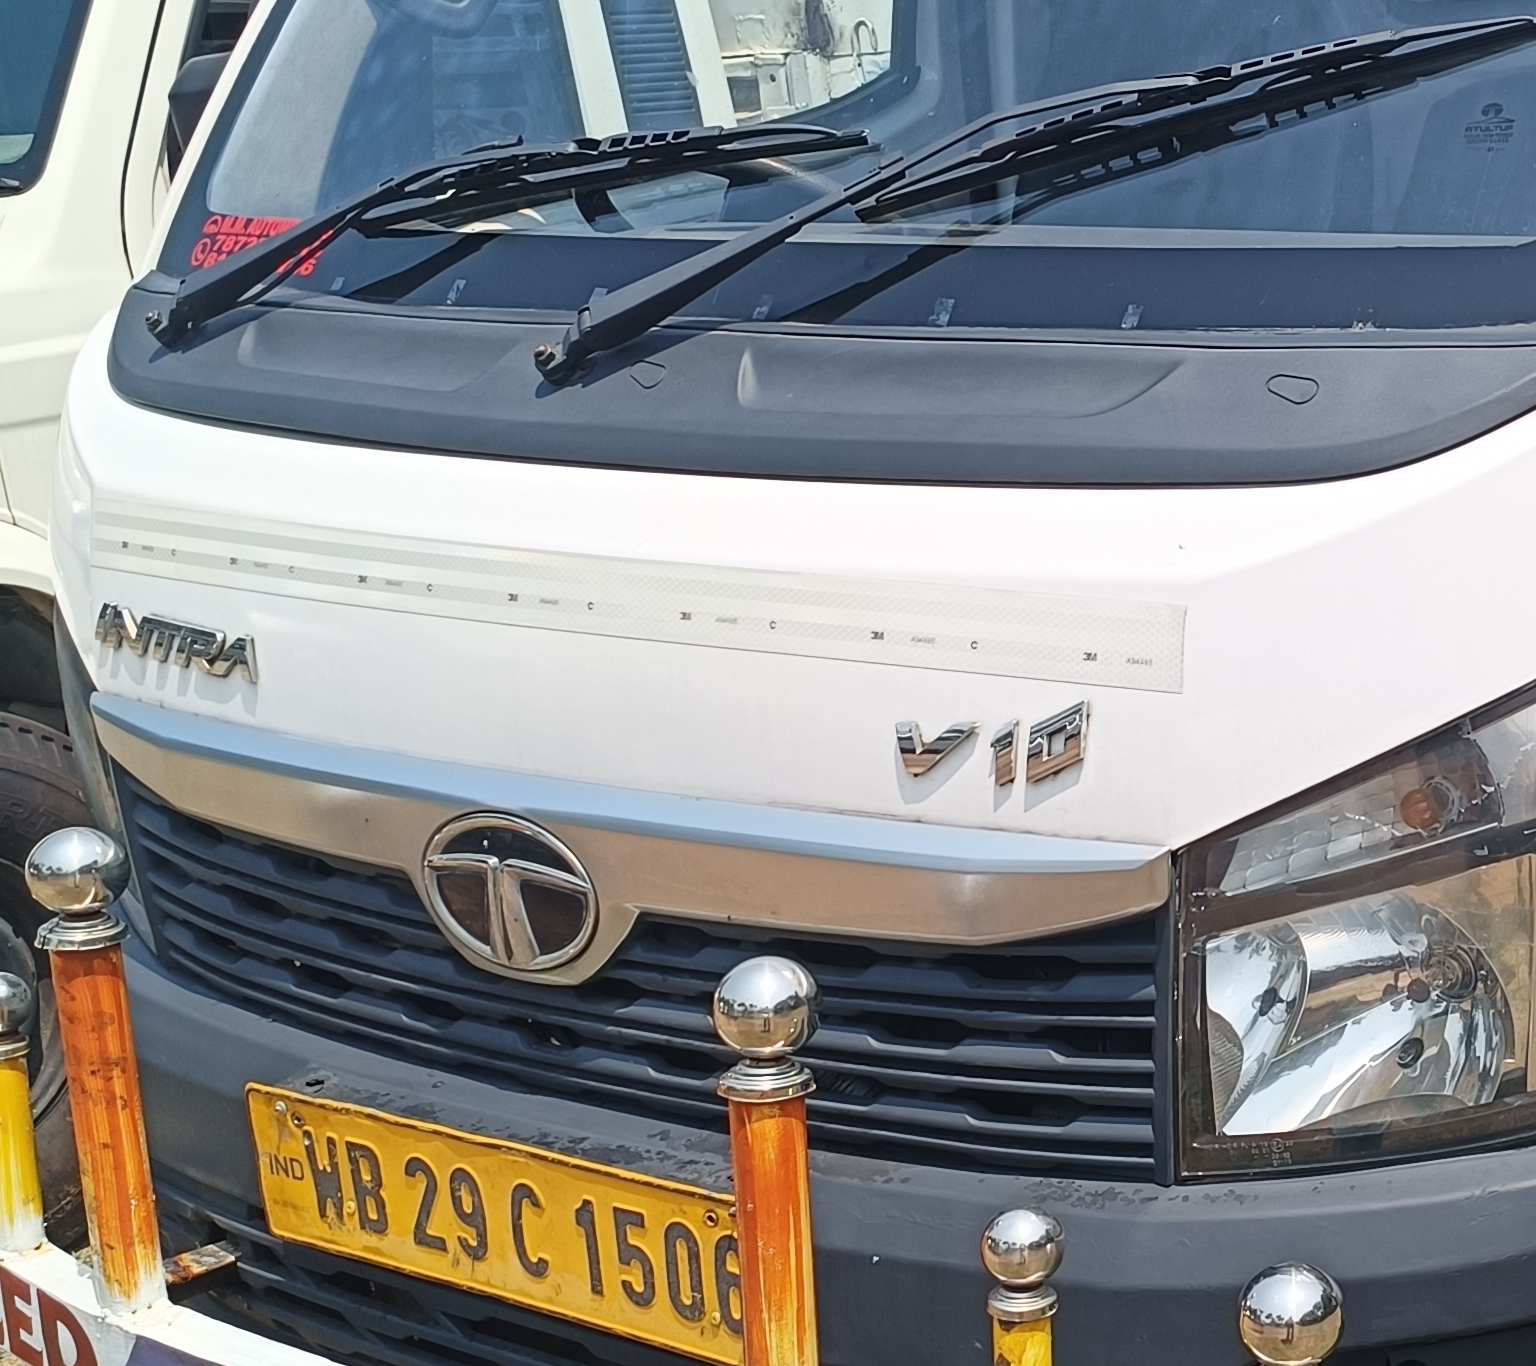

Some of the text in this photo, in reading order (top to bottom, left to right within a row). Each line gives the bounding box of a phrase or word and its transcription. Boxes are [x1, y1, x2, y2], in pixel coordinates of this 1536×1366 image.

[94, 601, 259, 684] INTRA
[268, 1152, 305, 1181] IND
[302, 1128, 744, 1335] WB 29 C 1506
